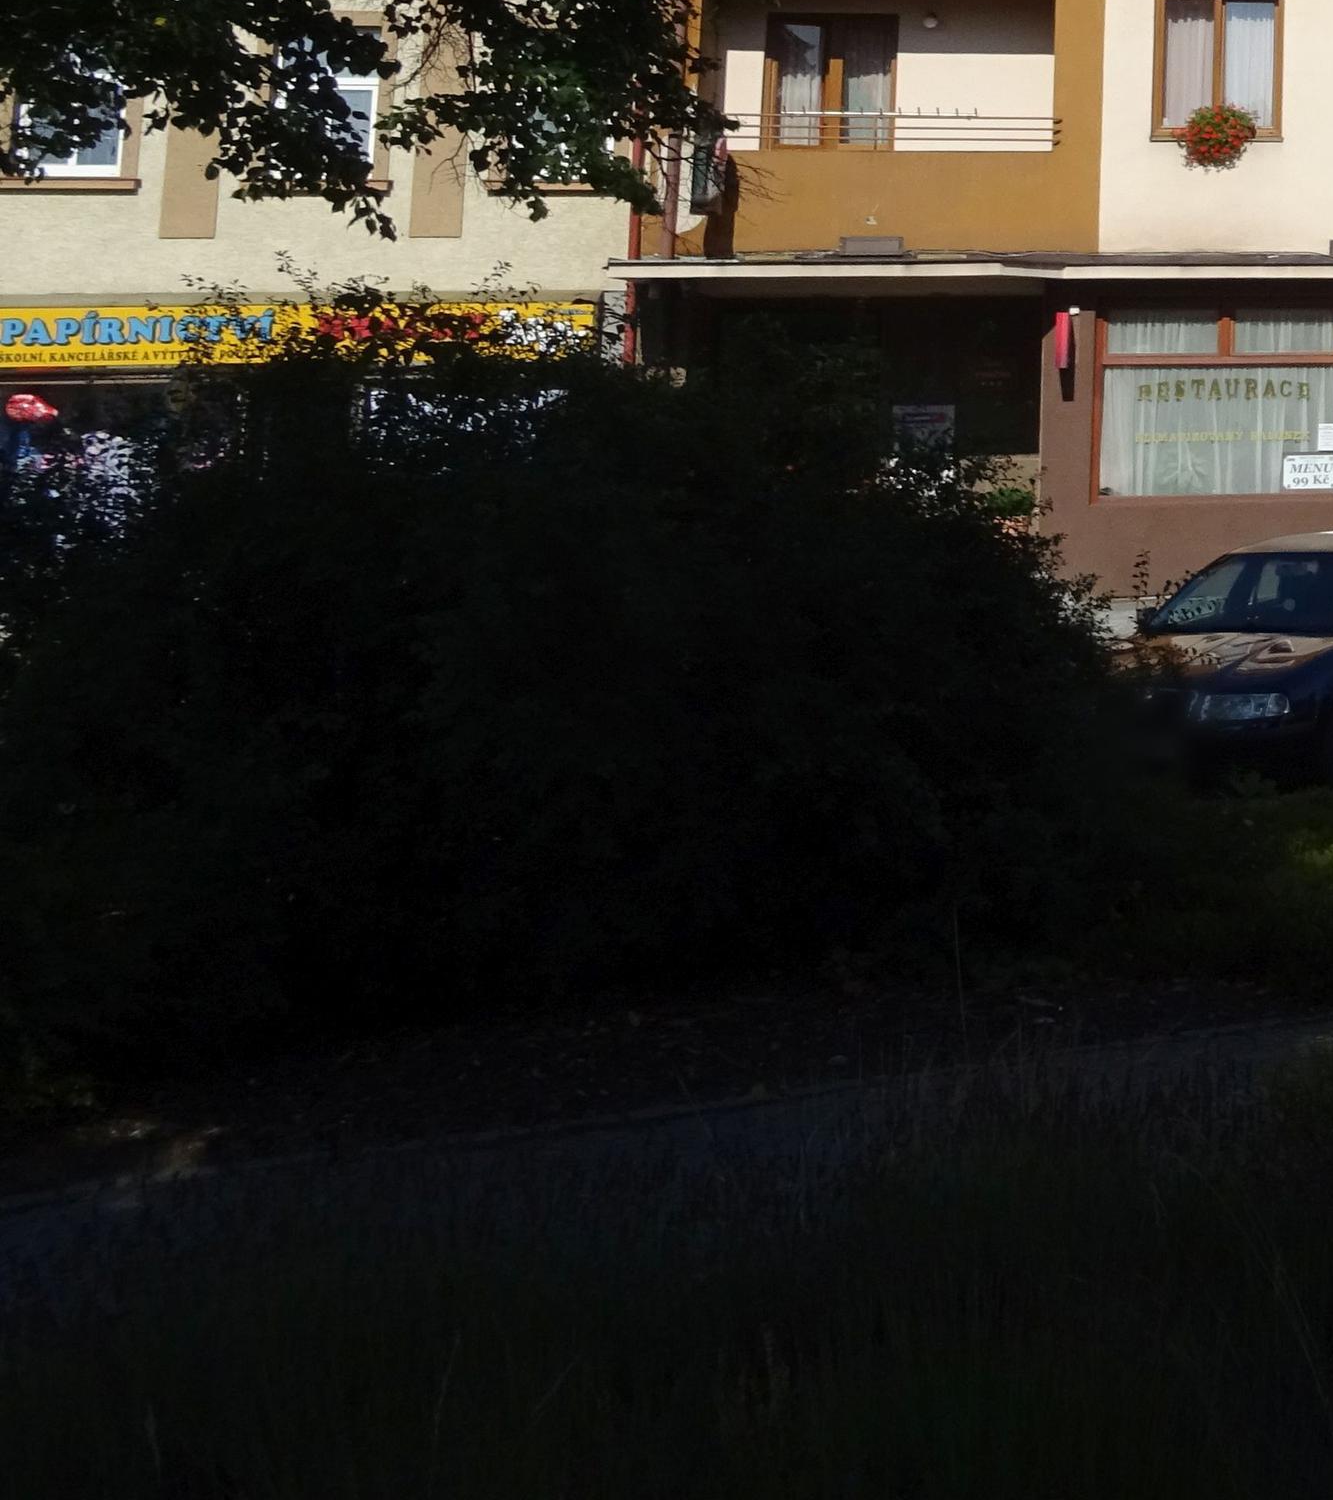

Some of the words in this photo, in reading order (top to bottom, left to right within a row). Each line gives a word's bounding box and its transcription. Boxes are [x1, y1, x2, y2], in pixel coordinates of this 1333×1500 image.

[142, 351, 150, 361] A
[1138, 378, 1311, 401] RESTAURACE
[1290, 463, 1333, 474] MENU
[1292, 477, 1309, 487] 99
[1313, 474, 1330, 485] Kč
